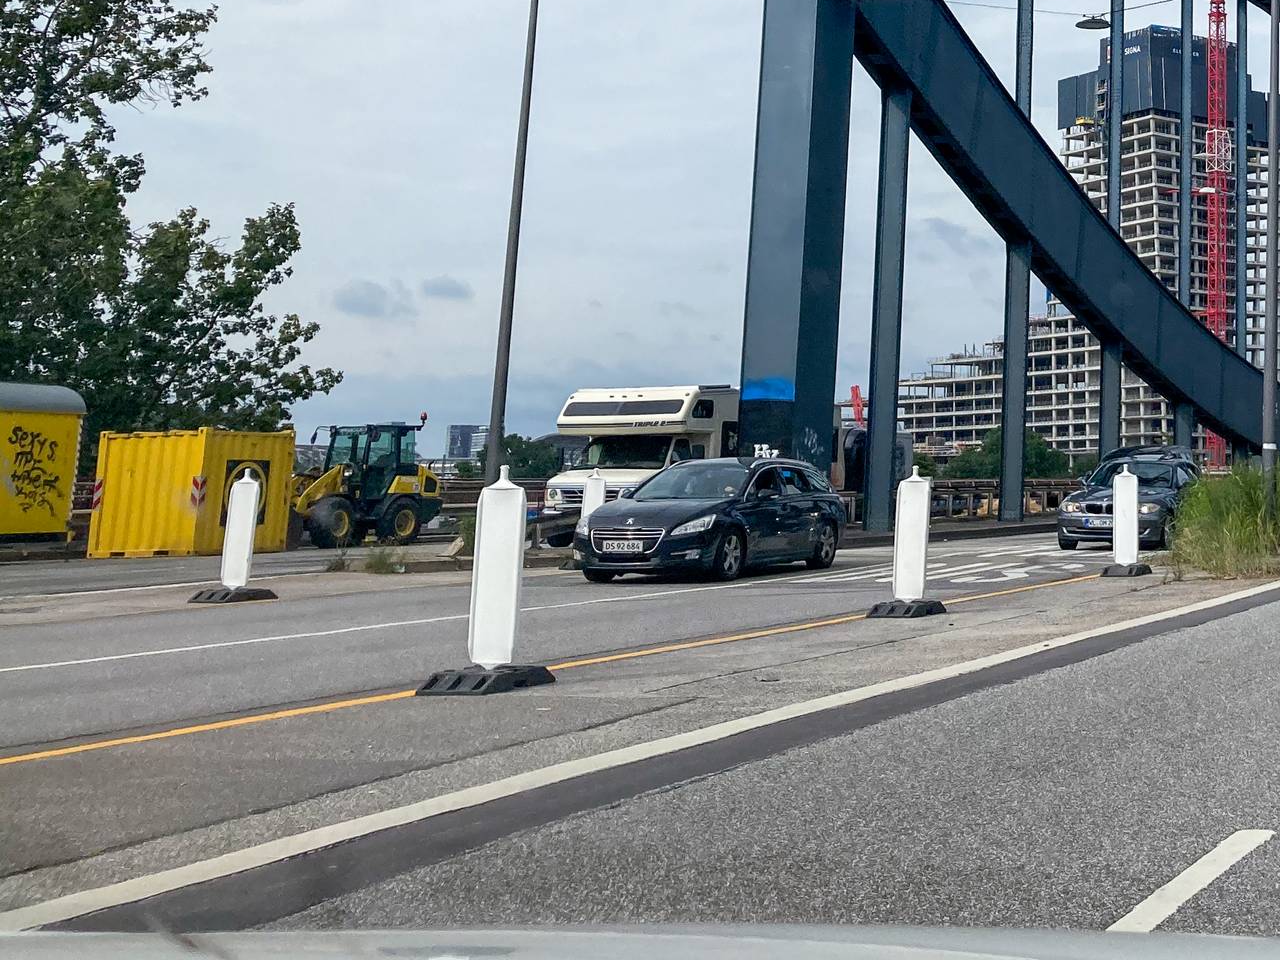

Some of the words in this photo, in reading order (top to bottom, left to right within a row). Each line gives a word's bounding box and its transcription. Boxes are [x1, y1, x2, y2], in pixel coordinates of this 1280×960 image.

[1124, 45, 1141, 56] SIGNA
[605, 542, 616, 550] DS
[616, 542, 626, 550] 92
[626, 542, 640, 550] 684
